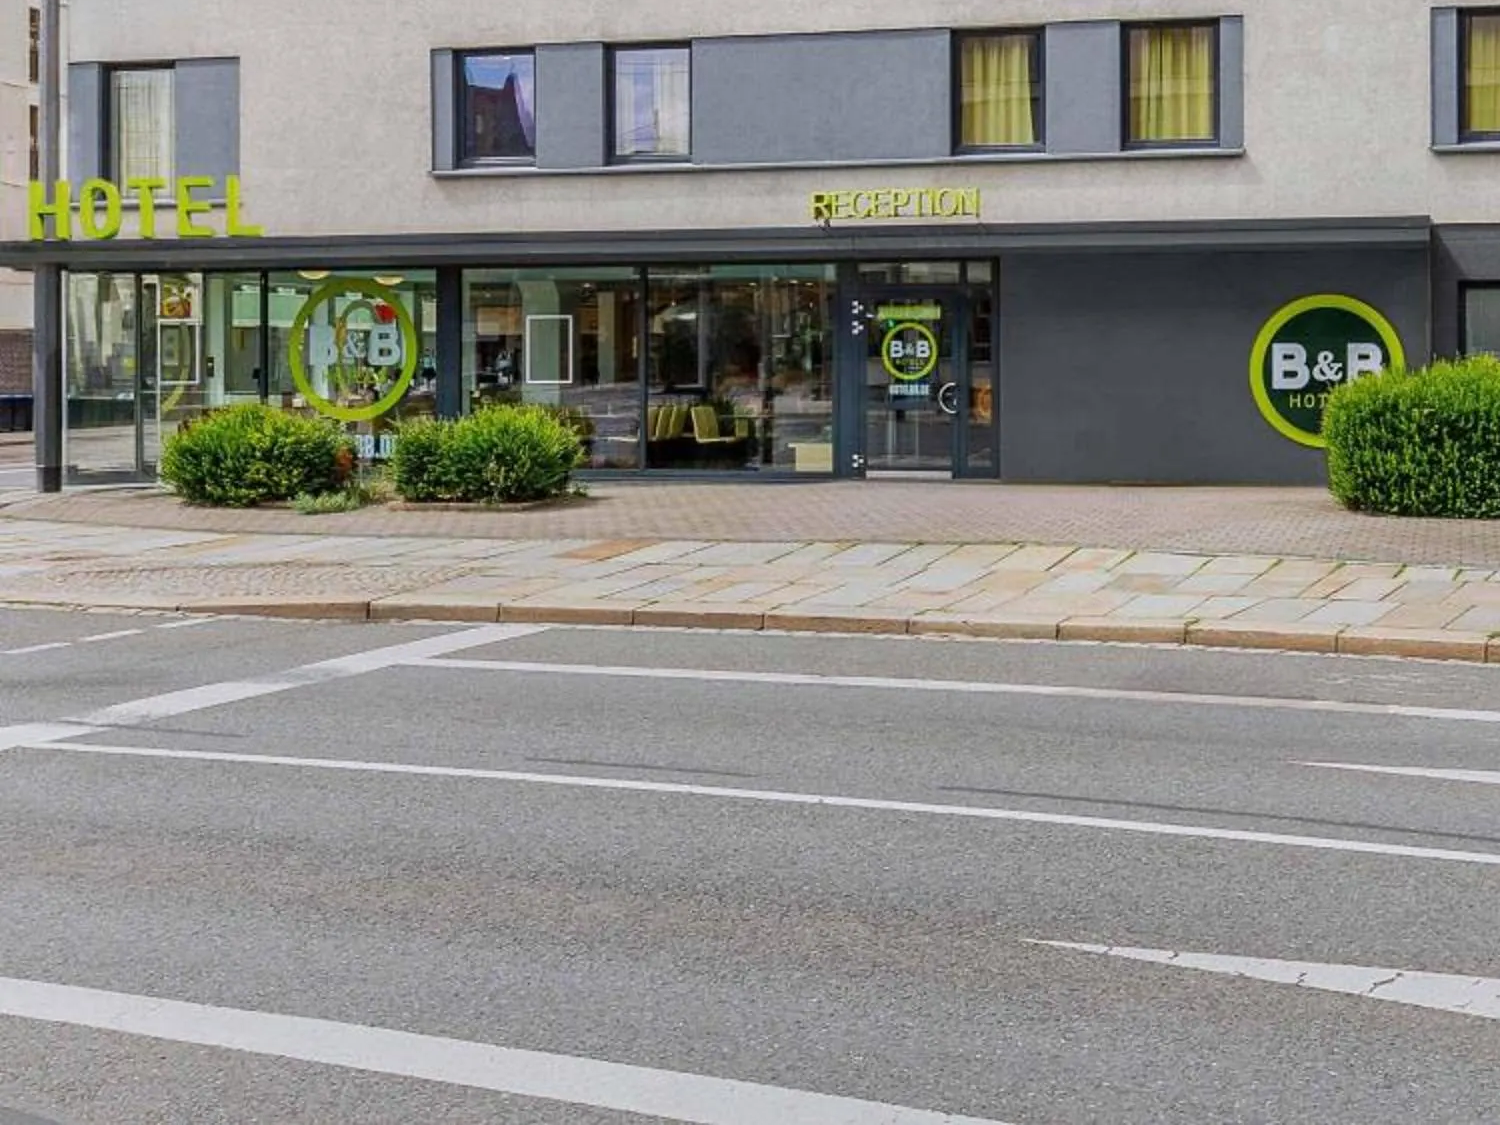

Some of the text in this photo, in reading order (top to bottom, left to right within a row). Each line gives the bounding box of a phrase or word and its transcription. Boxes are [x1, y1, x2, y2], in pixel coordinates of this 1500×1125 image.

[27, 174, 265, 241] HOTEL
[809, 187, 981, 220] RECEPTION
[890, 340, 931, 358] B&B
[1271, 342, 1383, 390] B&B
